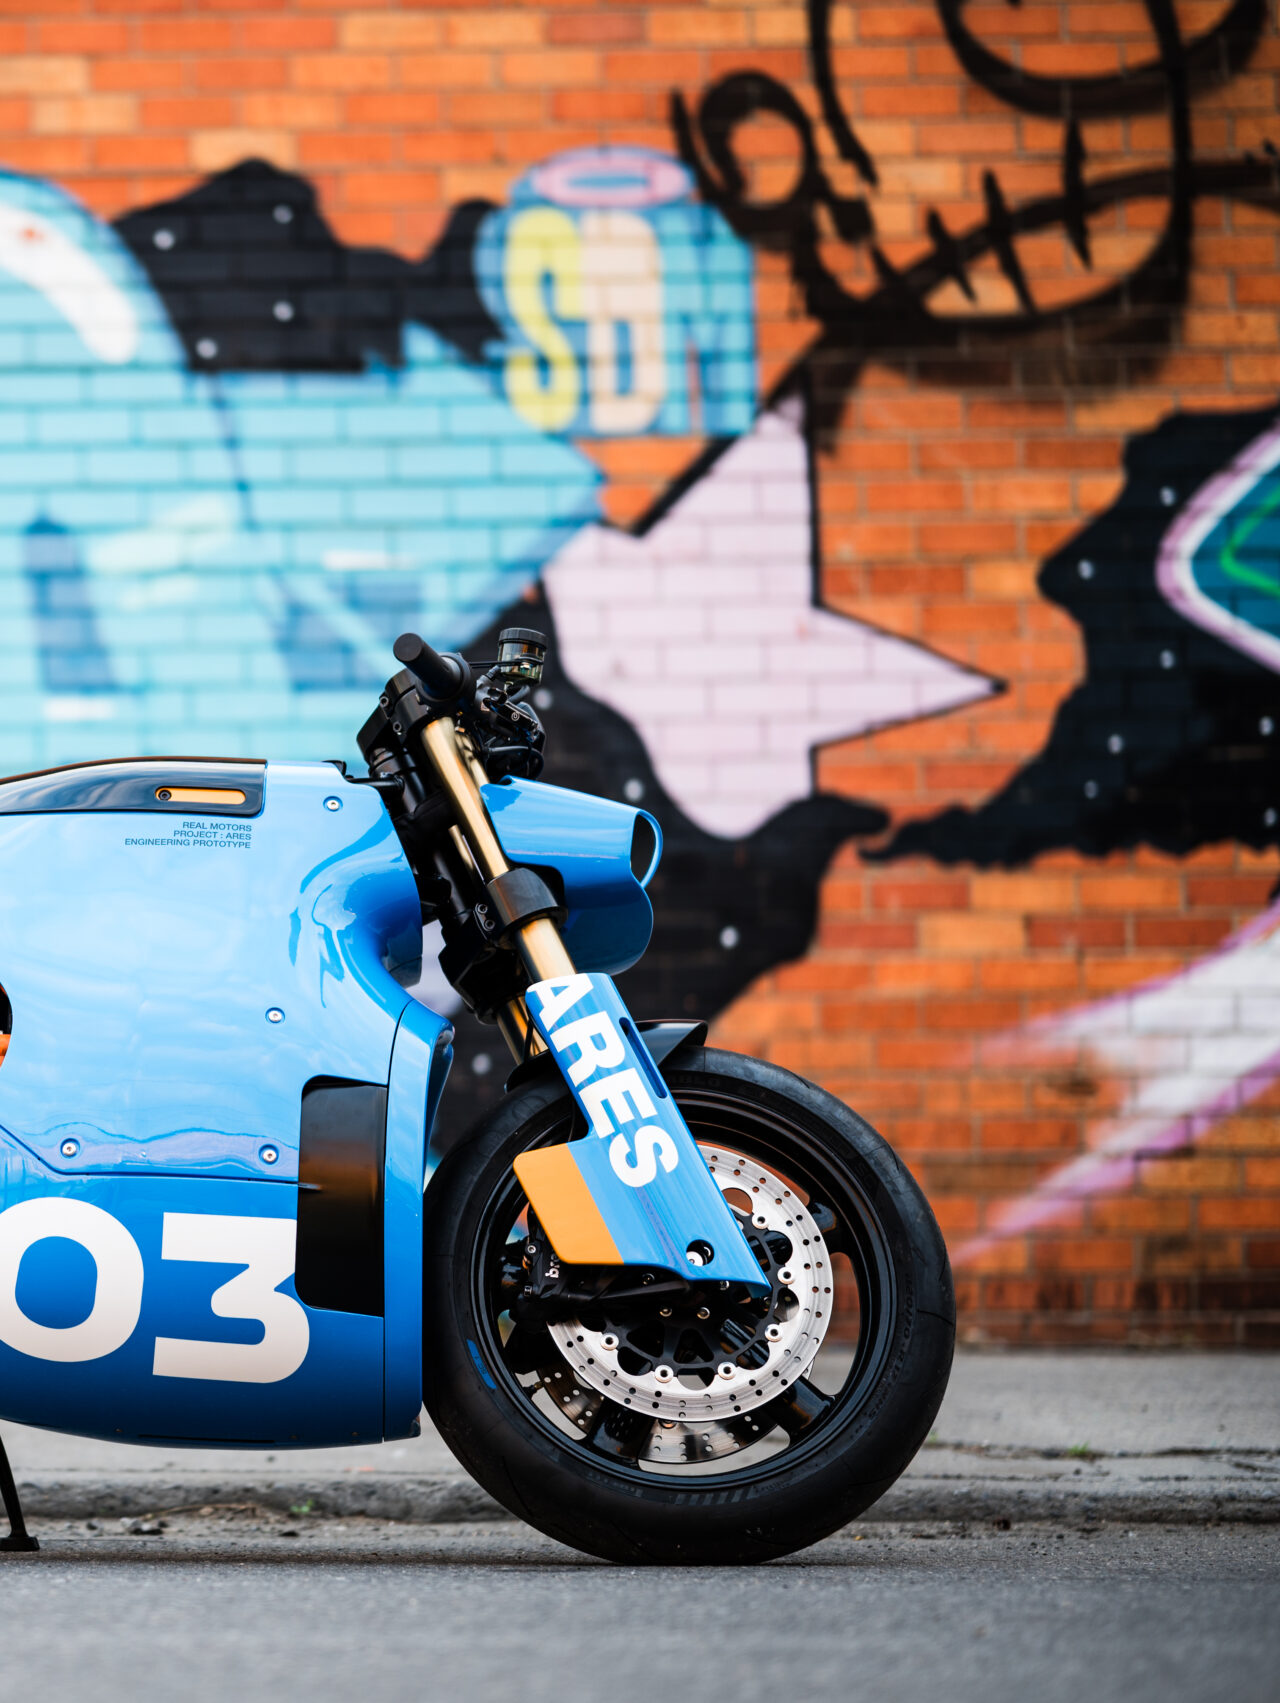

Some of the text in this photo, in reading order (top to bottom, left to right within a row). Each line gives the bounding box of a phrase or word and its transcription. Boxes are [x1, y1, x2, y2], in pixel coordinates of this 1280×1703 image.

[182, 821, 252, 832] REAL MOTORS
[173, 830, 219, 839] PROJECT
[225, 833, 252, 841] ARES
[124, 838, 251, 849] ENGINEERING PROTOTYPE
[528, 974, 679, 1188] ARES
